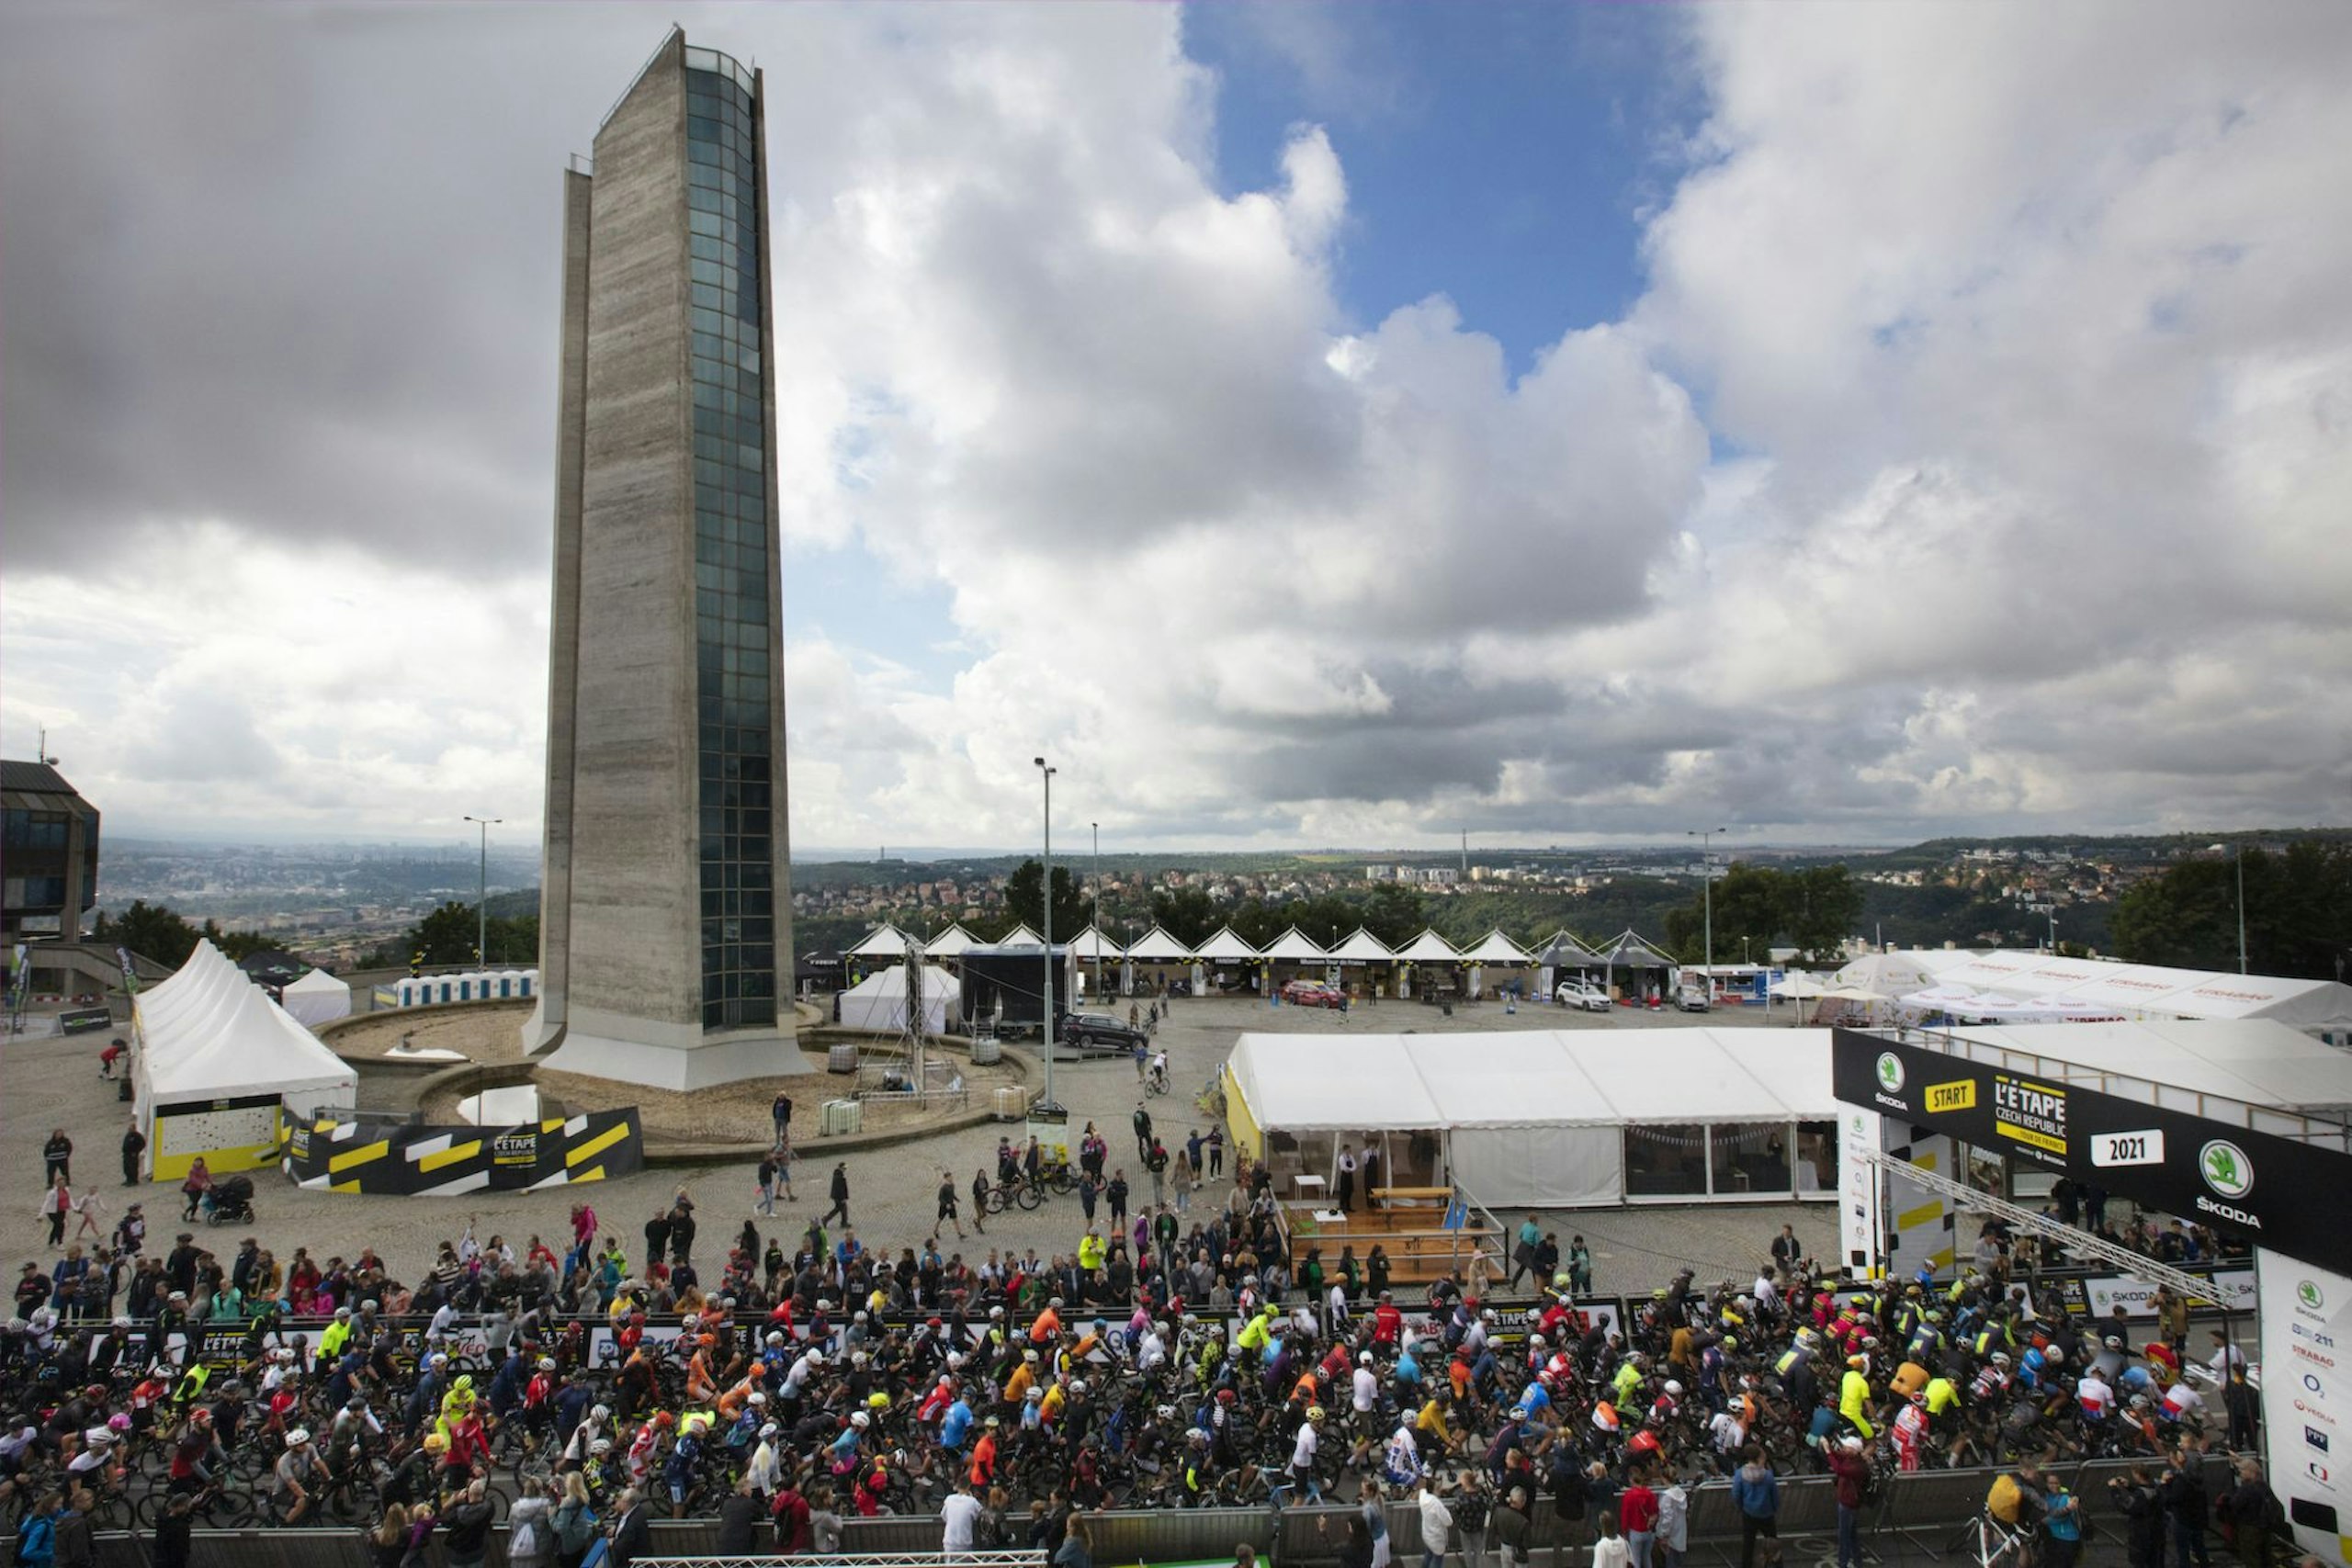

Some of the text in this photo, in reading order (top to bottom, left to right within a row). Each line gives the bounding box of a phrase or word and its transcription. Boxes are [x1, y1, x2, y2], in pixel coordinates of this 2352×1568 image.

[2192, 988, 2274, 1000] STRABAG
[1875, 1091, 1908, 1111] ŠKODA
[1934, 1086, 1967, 1107] START
[1995, 1079, 2065, 1122] L'ÉTAPE
[1996, 1106, 2066, 1138] CZECH REPUBLIC
[2109, 1137, 2145, 1160] 2021
[2197, 1196, 2262, 1230] ŠKODA
[2295, 1306, 2326, 1324] ŠKODA
[2314, 1333, 2335, 1348] 211
[2292, 1344, 2335, 1367] STRABAG
[2305, 1404, 2335, 1426] VEOLIA
[2307, 1428, 2326, 1444] PPF
